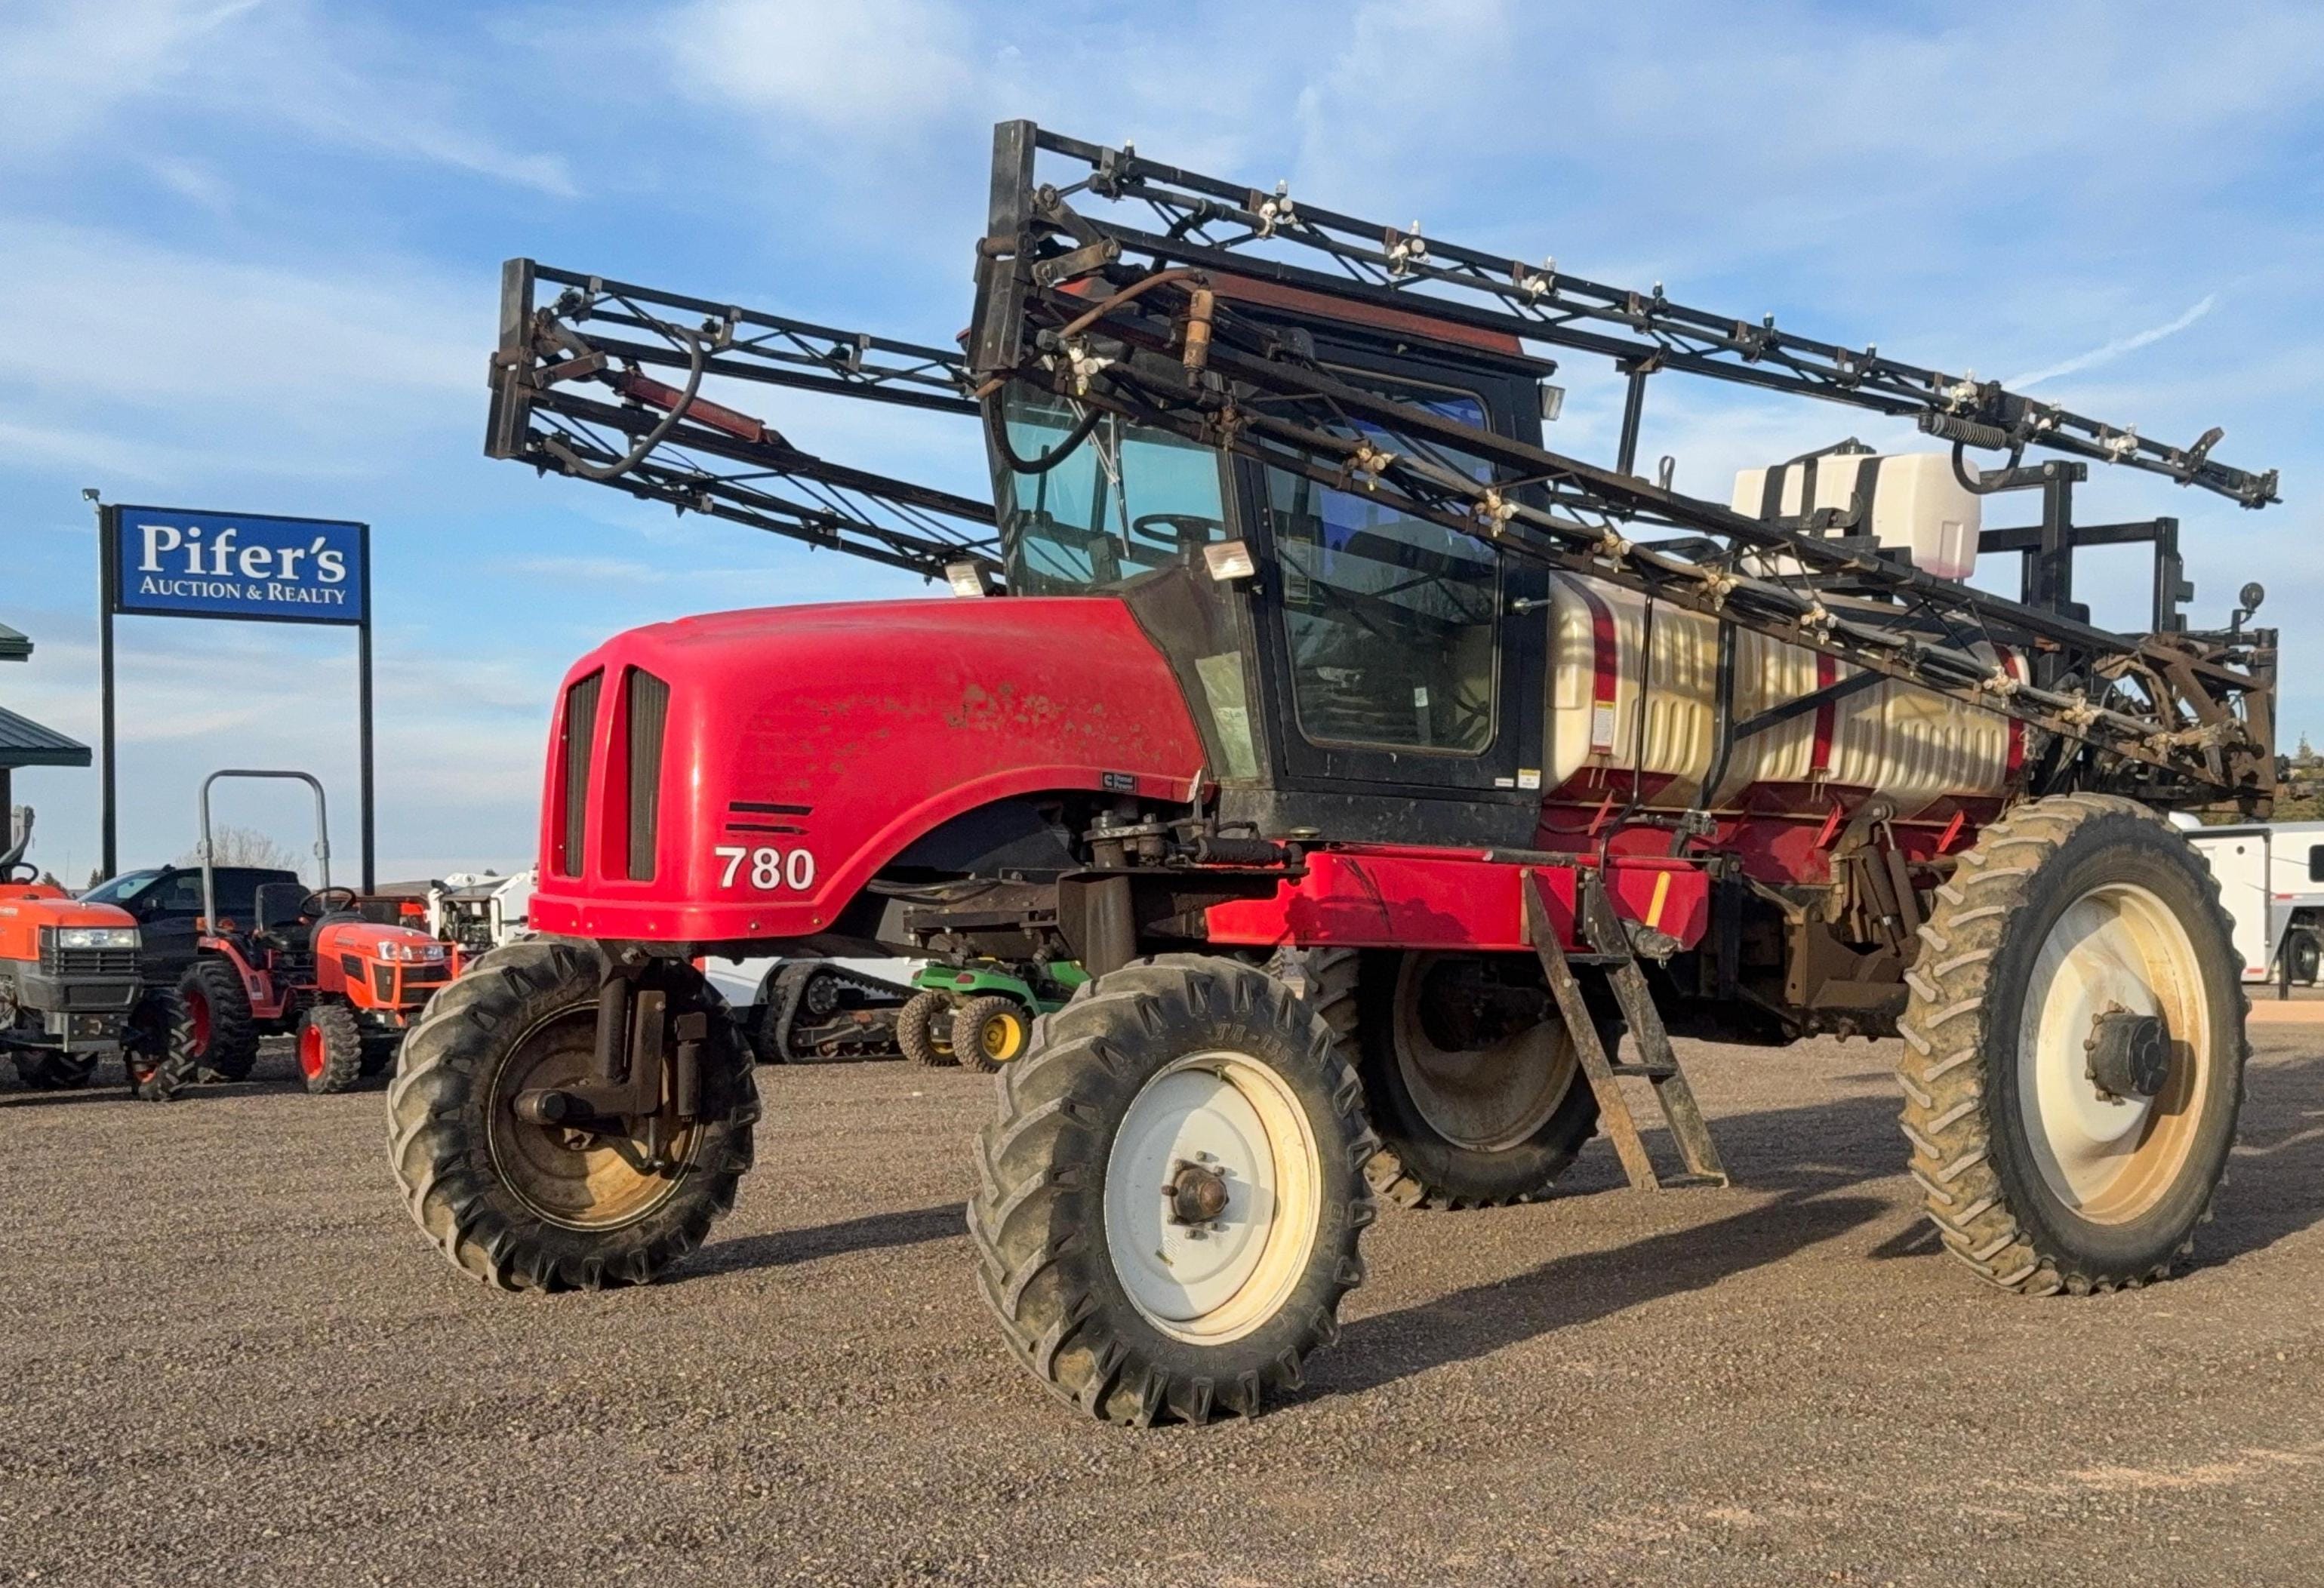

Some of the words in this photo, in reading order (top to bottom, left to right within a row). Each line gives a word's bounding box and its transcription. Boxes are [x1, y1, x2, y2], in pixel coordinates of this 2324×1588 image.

[137, 525, 346, 583] Pifer's
[140, 576, 240, 599] AUCTION
[247, 586, 263, 601] &
[267, 582, 346, 605] REALTY
[715, 846, 815, 891] 780
